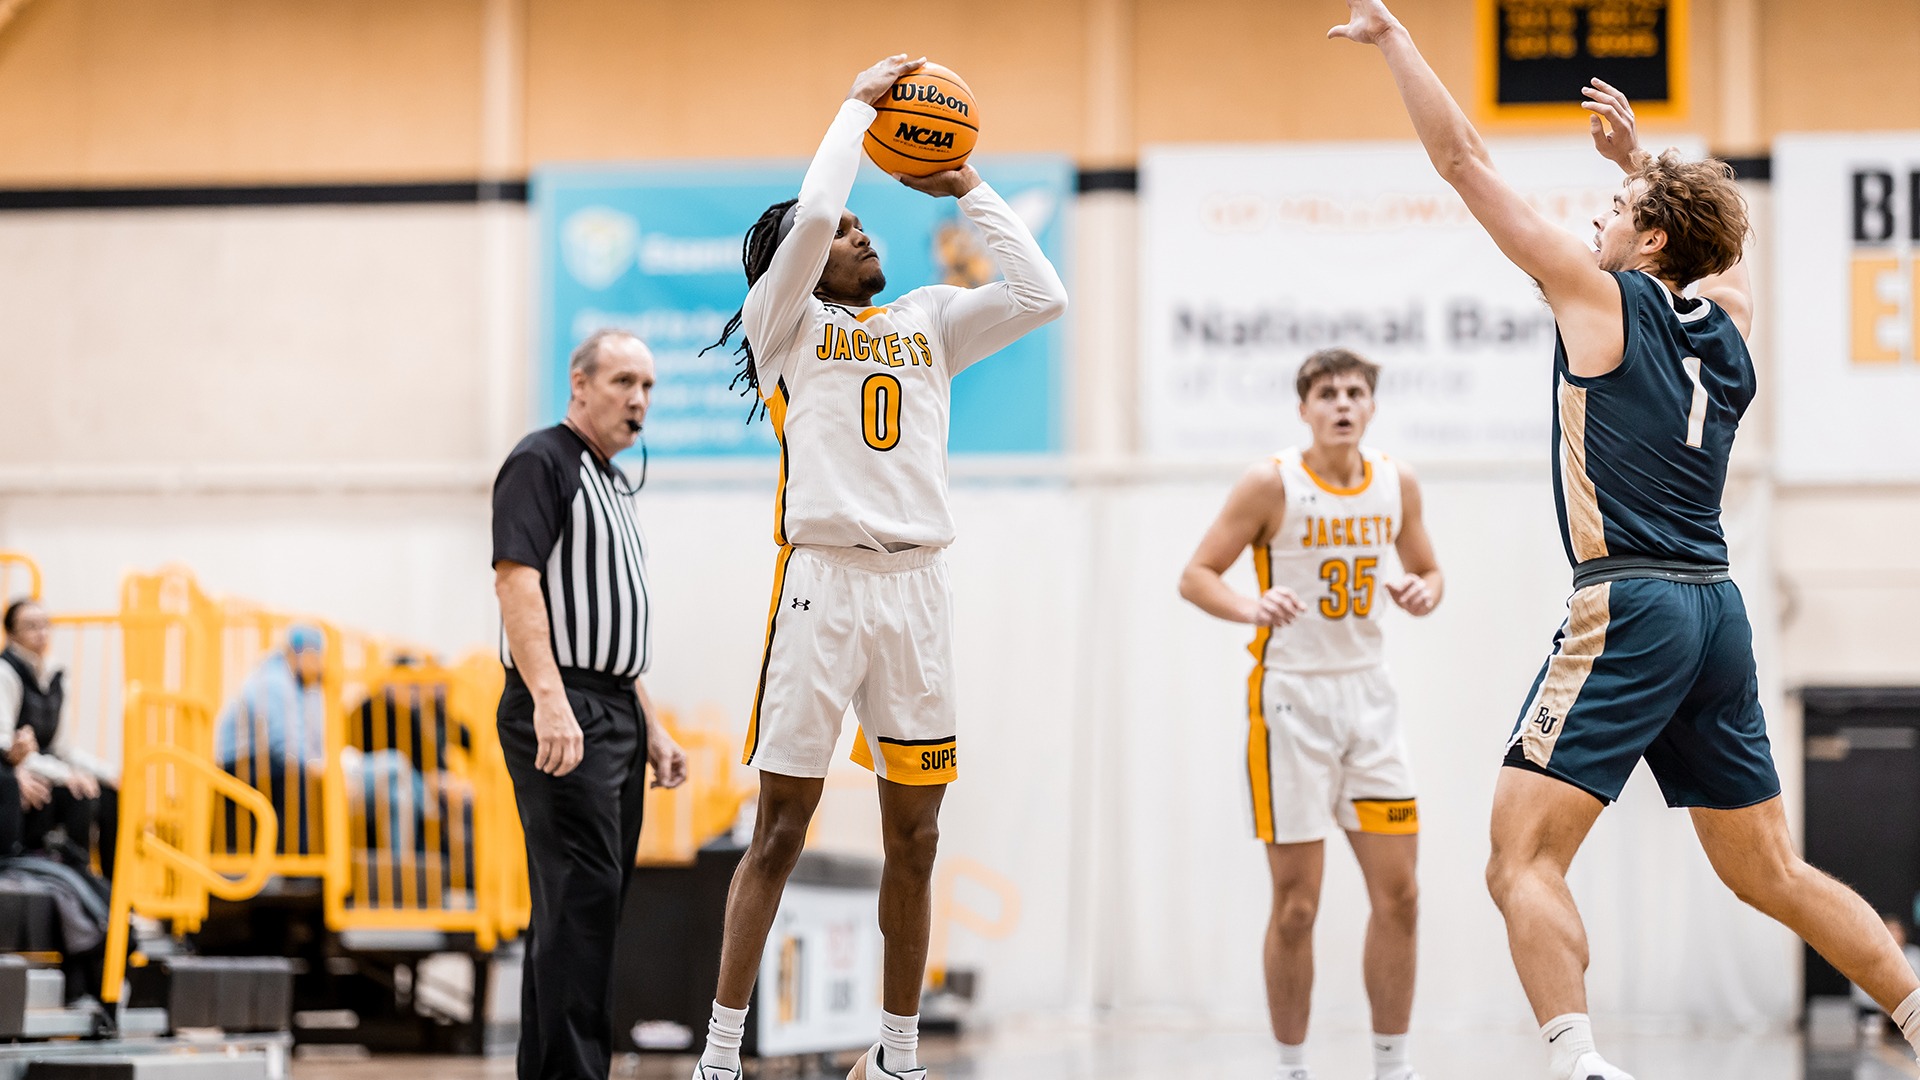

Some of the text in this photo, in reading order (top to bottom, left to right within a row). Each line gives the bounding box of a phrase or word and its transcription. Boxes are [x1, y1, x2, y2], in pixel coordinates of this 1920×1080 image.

[891, 83, 969, 117] Wilson
[895, 122, 954, 149] NCAA
[1174, 302, 1553, 346] National Ban
[816, 323, 933, 368] JACKETS
[861, 373, 902, 451] 0
[1682, 356, 1709, 449] 1
[1301, 516, 1394, 548] JACKETS
[1319, 557, 1378, 620] 35
[1534, 706, 1557, 734] BU
[921, 747, 956, 770] SUPE
